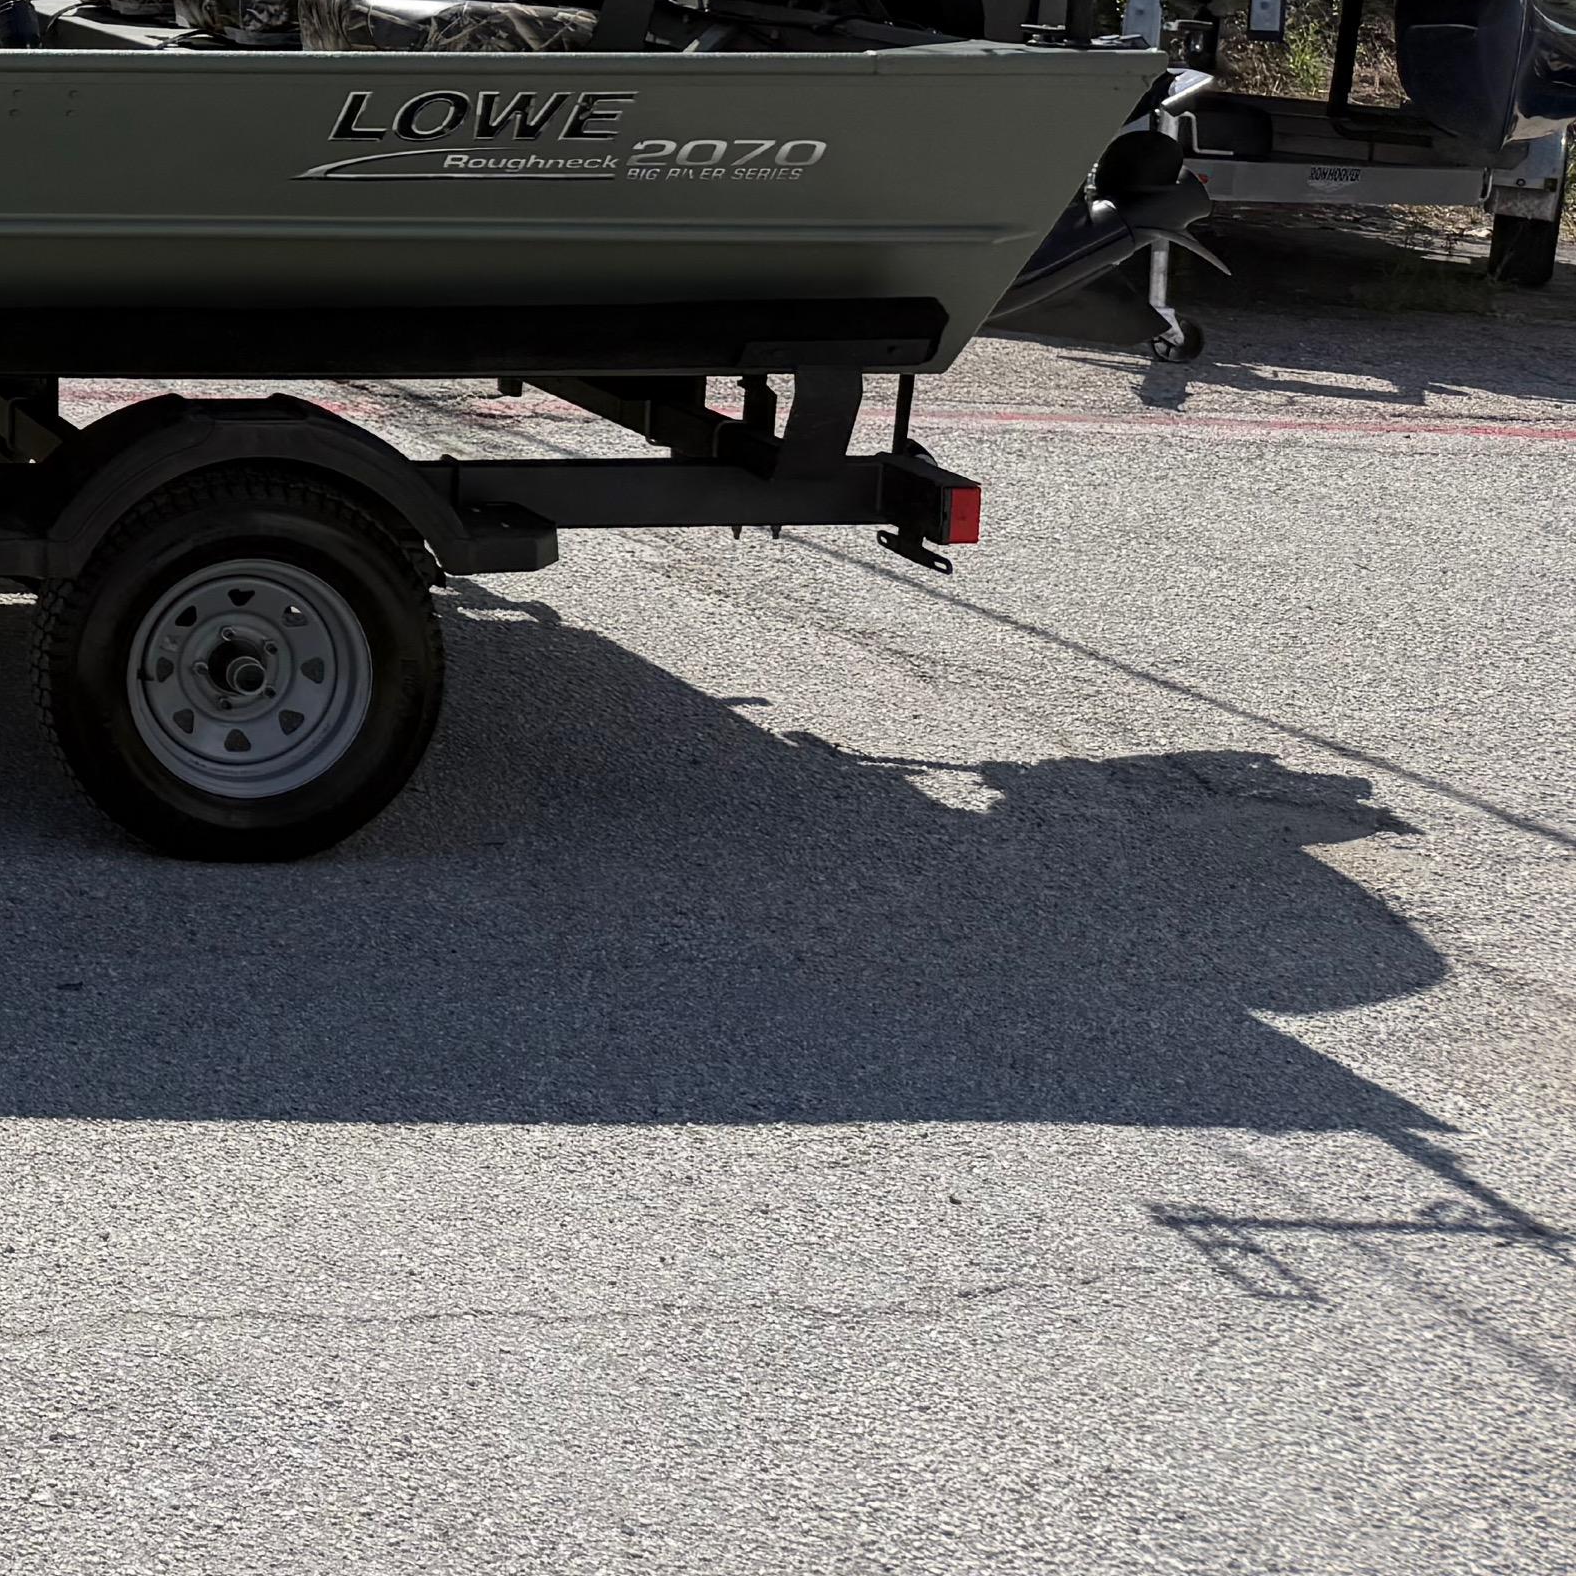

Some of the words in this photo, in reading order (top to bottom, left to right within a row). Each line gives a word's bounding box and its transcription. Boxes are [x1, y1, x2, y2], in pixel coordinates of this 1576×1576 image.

[328, 90, 640, 142] LOWE
[442, 154, 620, 173] Roughneck
[626, 139, 828, 167] 2070
[626, 168, 661, 181] BIG
[730, 168, 804, 181] SERIES
